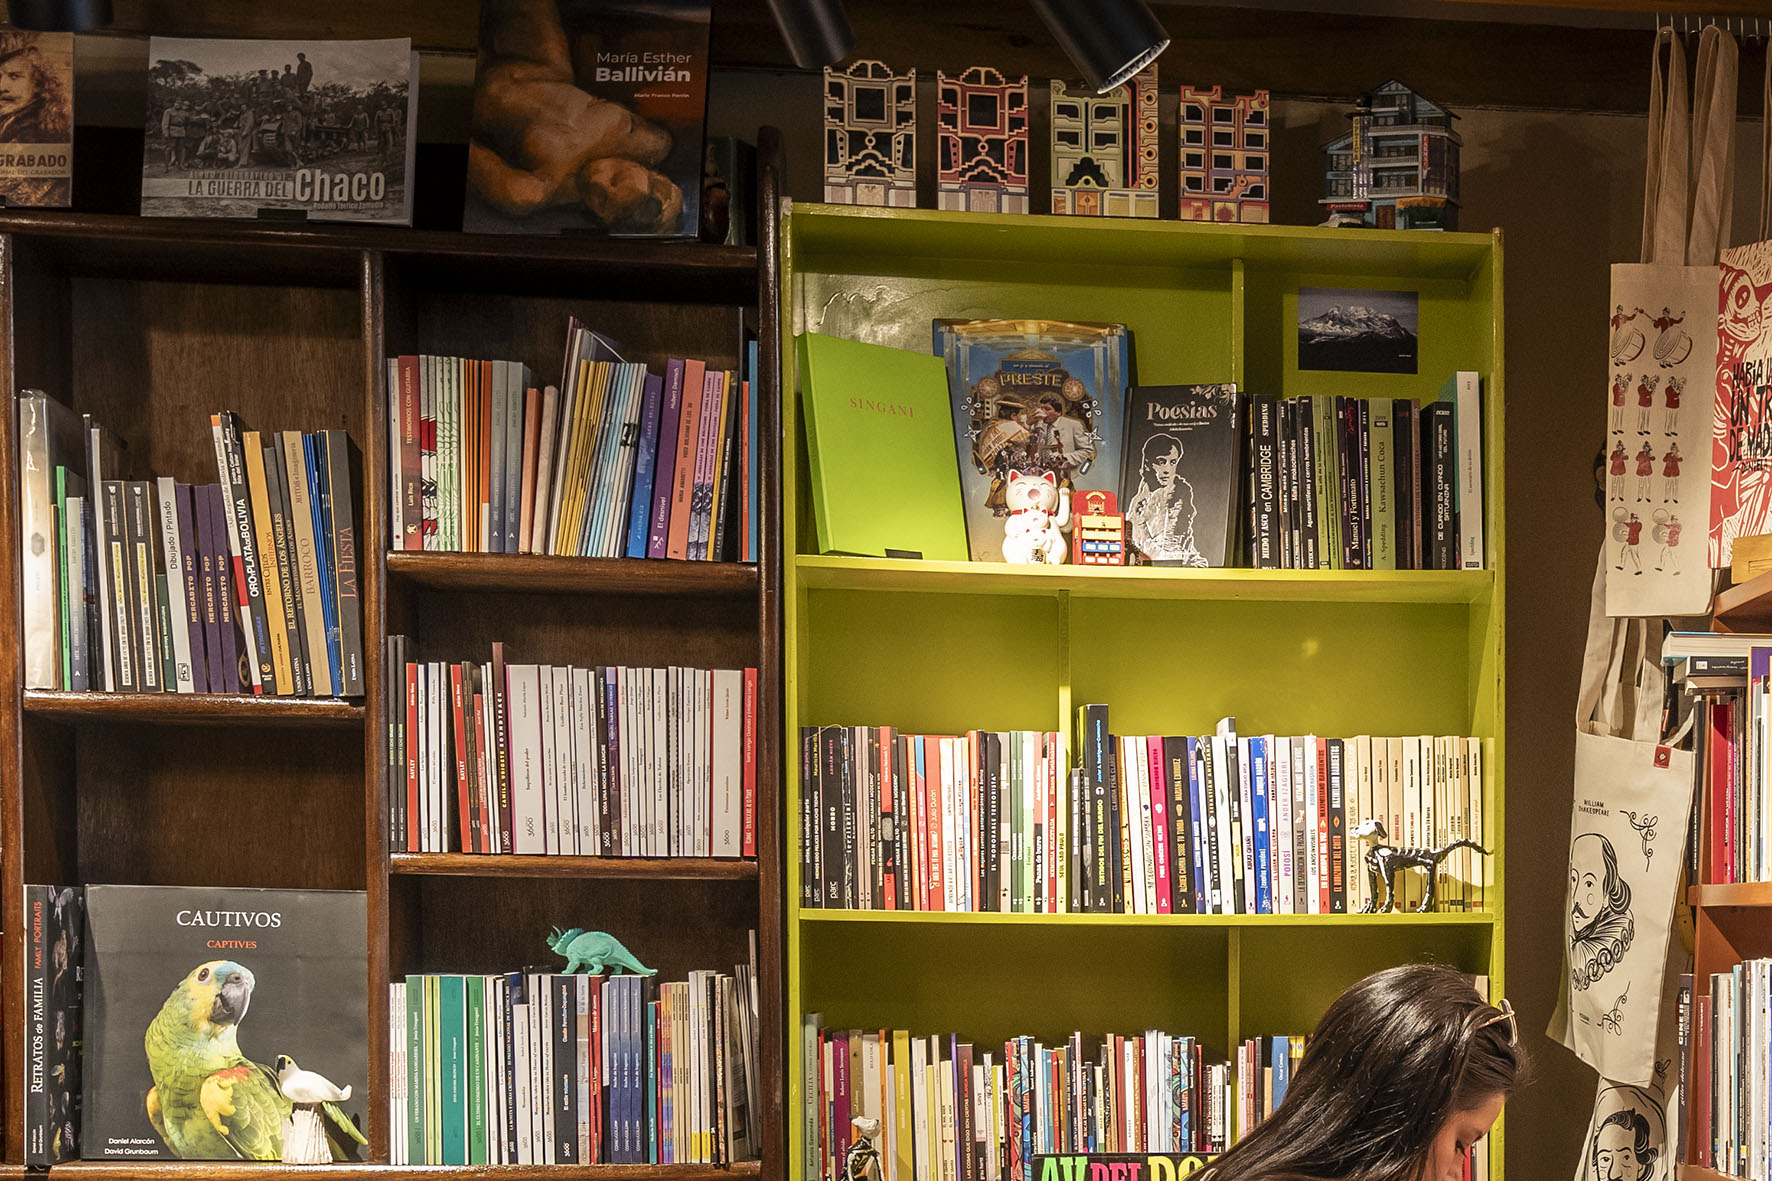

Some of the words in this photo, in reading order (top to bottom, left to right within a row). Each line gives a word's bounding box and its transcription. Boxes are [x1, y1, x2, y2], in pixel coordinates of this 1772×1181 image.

[596, 52, 638, 64] María
[643, 52, 692, 64] Esther
[595, 66, 691, 82] Ballivián
[188, 181, 203, 196] LA
[208, 181, 260, 198] GUERRA
[265, 182, 289, 198] DEL
[294, 168, 385, 202] Chaco
[848, 396, 915, 419] SINGANI
[1261, 403, 1270, 436] SPEDDING
[1731, 386, 1750, 427] UN
[1377, 441, 1385, 463] Coca
[1729, 427, 1743, 462] DE
[1260, 444, 1273, 500] CAMBRIDGE
[1349, 478, 1358, 514] Fortunato
[1378, 464, 1387, 513] Kawsachun
[163, 500, 174, 529] Pintado
[236, 499, 250, 538] BOLIVIA
[658, 496, 666, 521] desnivel
[1263, 501, 1272, 513] en
[273, 513, 286, 551] ÁNGELES
[657, 521, 663, 529] El
[1351, 521, 1359, 550] Manuel
[169, 537, 179, 570] Dibujado
[185, 555, 194, 571] POP
[203, 555, 211, 572] POP
[243, 544, 255, 573] PLATA
[278, 551, 287, 567] LOS
[338, 527, 354, 573] FIESTA
[280, 567, 289, 578] DE
[299, 537, 316, 595] BARROCO
[186, 575, 198, 623] MERCADITO
[204, 576, 215, 624] MERCADITO
[247, 576, 259, 598] ORO
[282, 579, 295, 619] RETORNO
[340, 578, 357, 599] LA
[287, 619, 297, 630] EL
[1283, 850, 1291, 877] POTOSÍ
[830, 881, 839, 899] parc
[33, 902, 42, 942] PORTRAITS
[176, 910, 281, 928] CAUTIVOS
[206, 939, 258, 950] CAPTIVES
[33, 977, 43, 1020] FAMILIA
[31, 1036, 43, 1093] RETRATOS
[104, 1148, 123, 1156] David
[108, 1137, 129, 1145] Daniel
[130, 1136, 155, 1145] Alarcón
